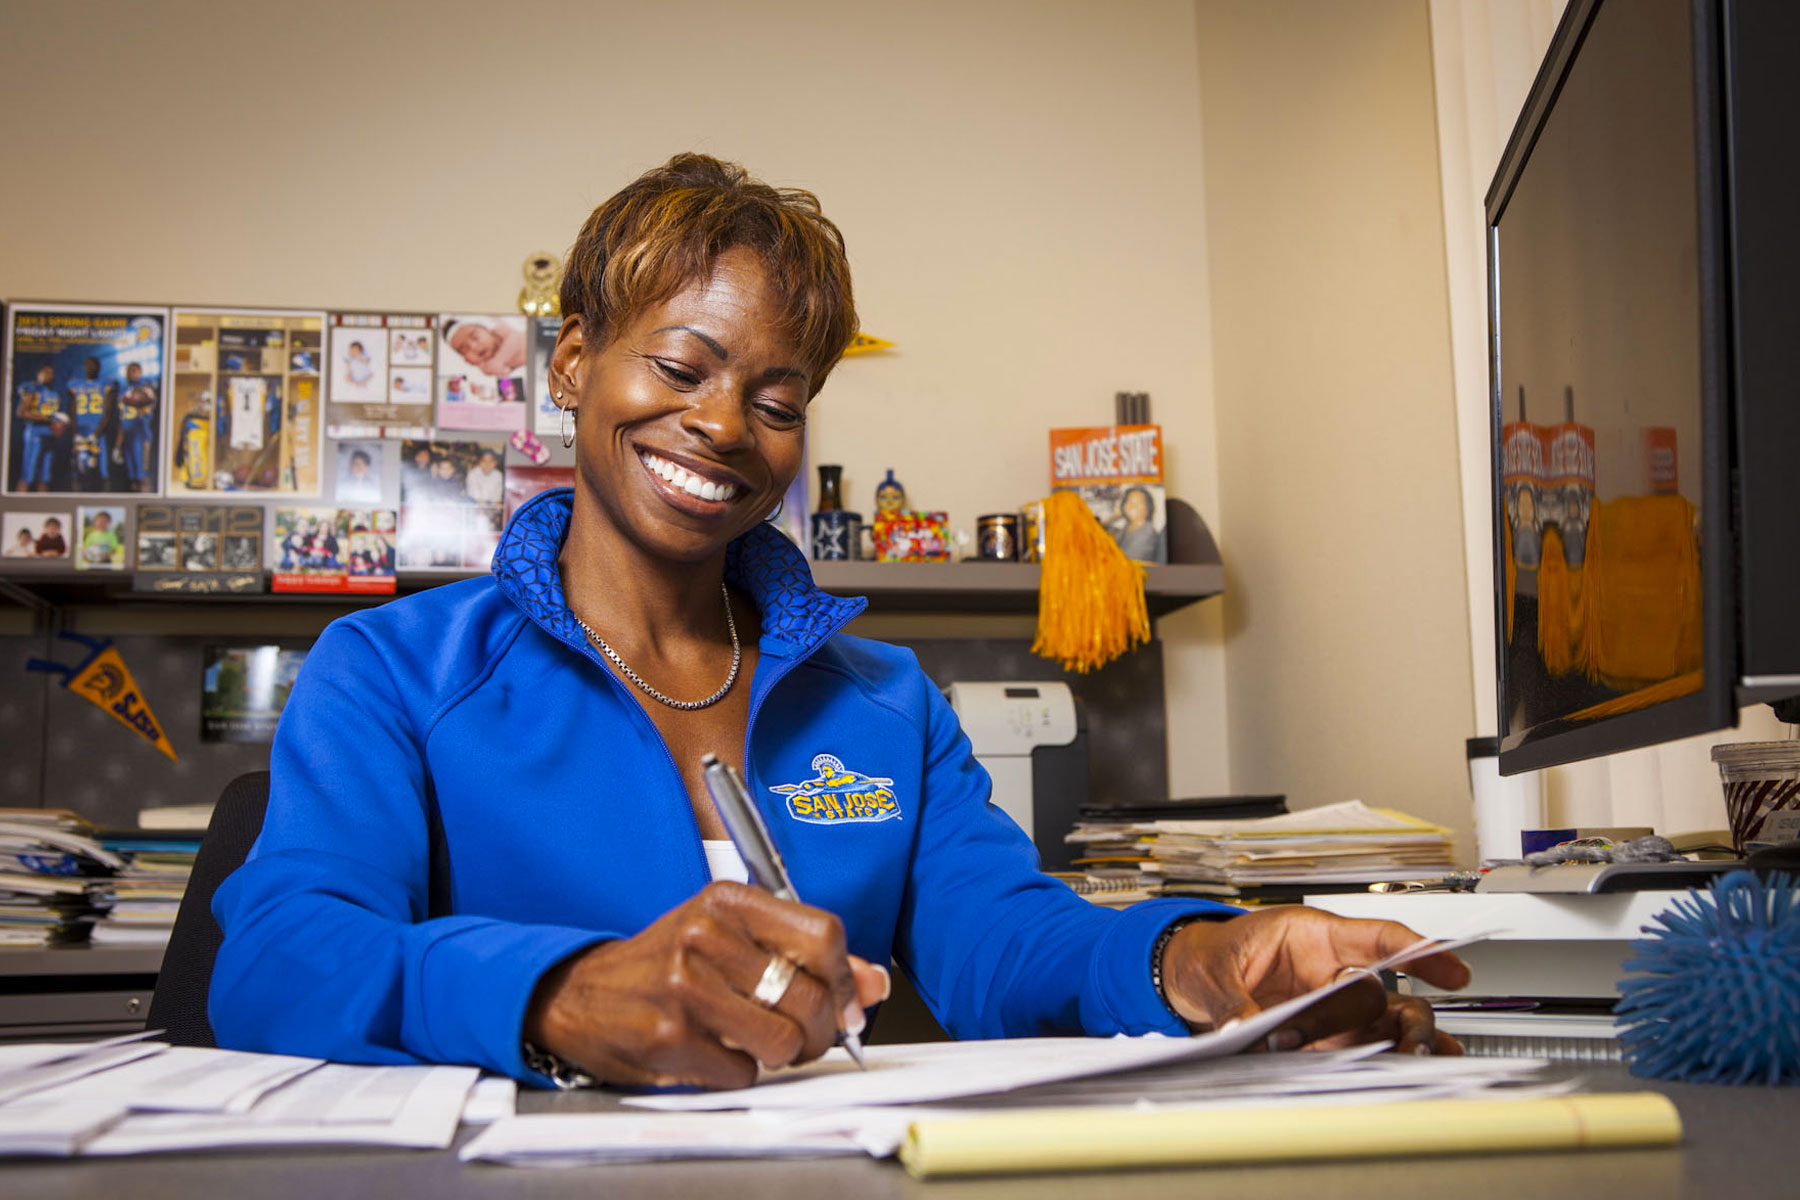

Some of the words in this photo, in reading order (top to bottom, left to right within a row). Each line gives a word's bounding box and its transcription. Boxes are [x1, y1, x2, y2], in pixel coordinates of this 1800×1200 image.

[76, 393, 104, 415] 22
[1054, 443, 1083, 479] SAN
[1118, 429, 1159, 477] STATE
[140, 505, 262, 532] 2012
[792, 794, 841, 815] SAN
[843, 789, 895, 810] JOSE
[825, 807, 874, 819] STATE
